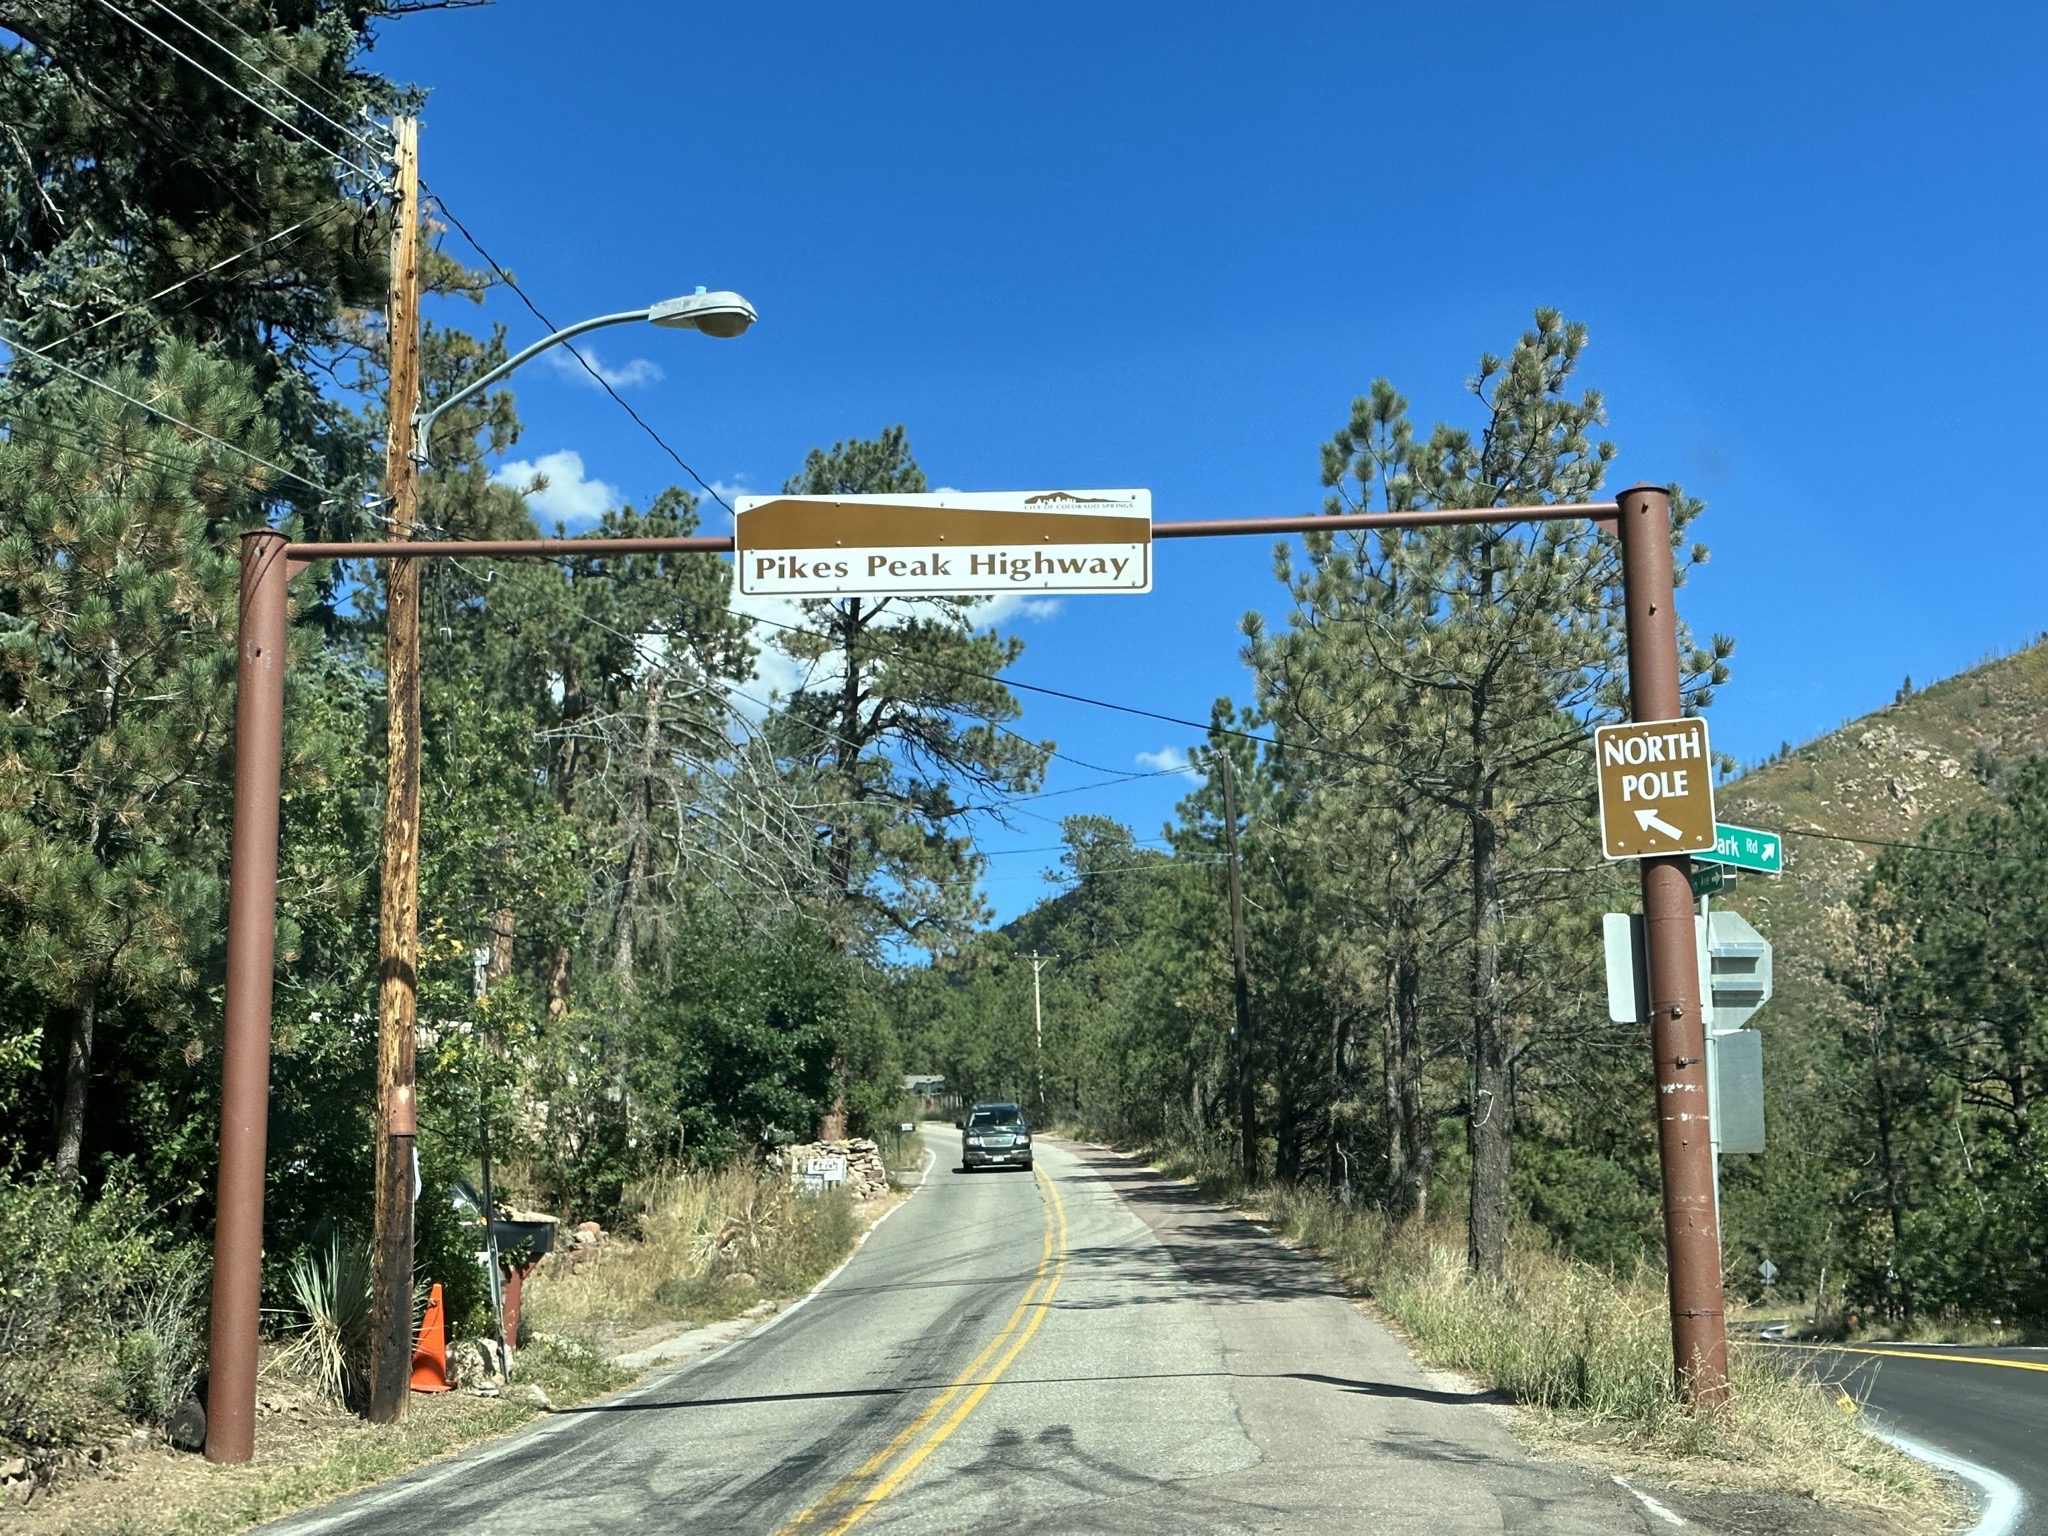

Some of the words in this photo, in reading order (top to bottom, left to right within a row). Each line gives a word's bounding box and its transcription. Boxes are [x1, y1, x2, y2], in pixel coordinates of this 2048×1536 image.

[755, 555, 849, 581] Pikes
[867, 553, 952, 578] Peak
[970, 551, 1130, 582] Highway
[1604, 731, 1701, 767] NORTH
[1622, 769, 1689, 802] POLE
[1717, 835, 1740, 858] ark
[1746, 837, 1759, 855] Rd
